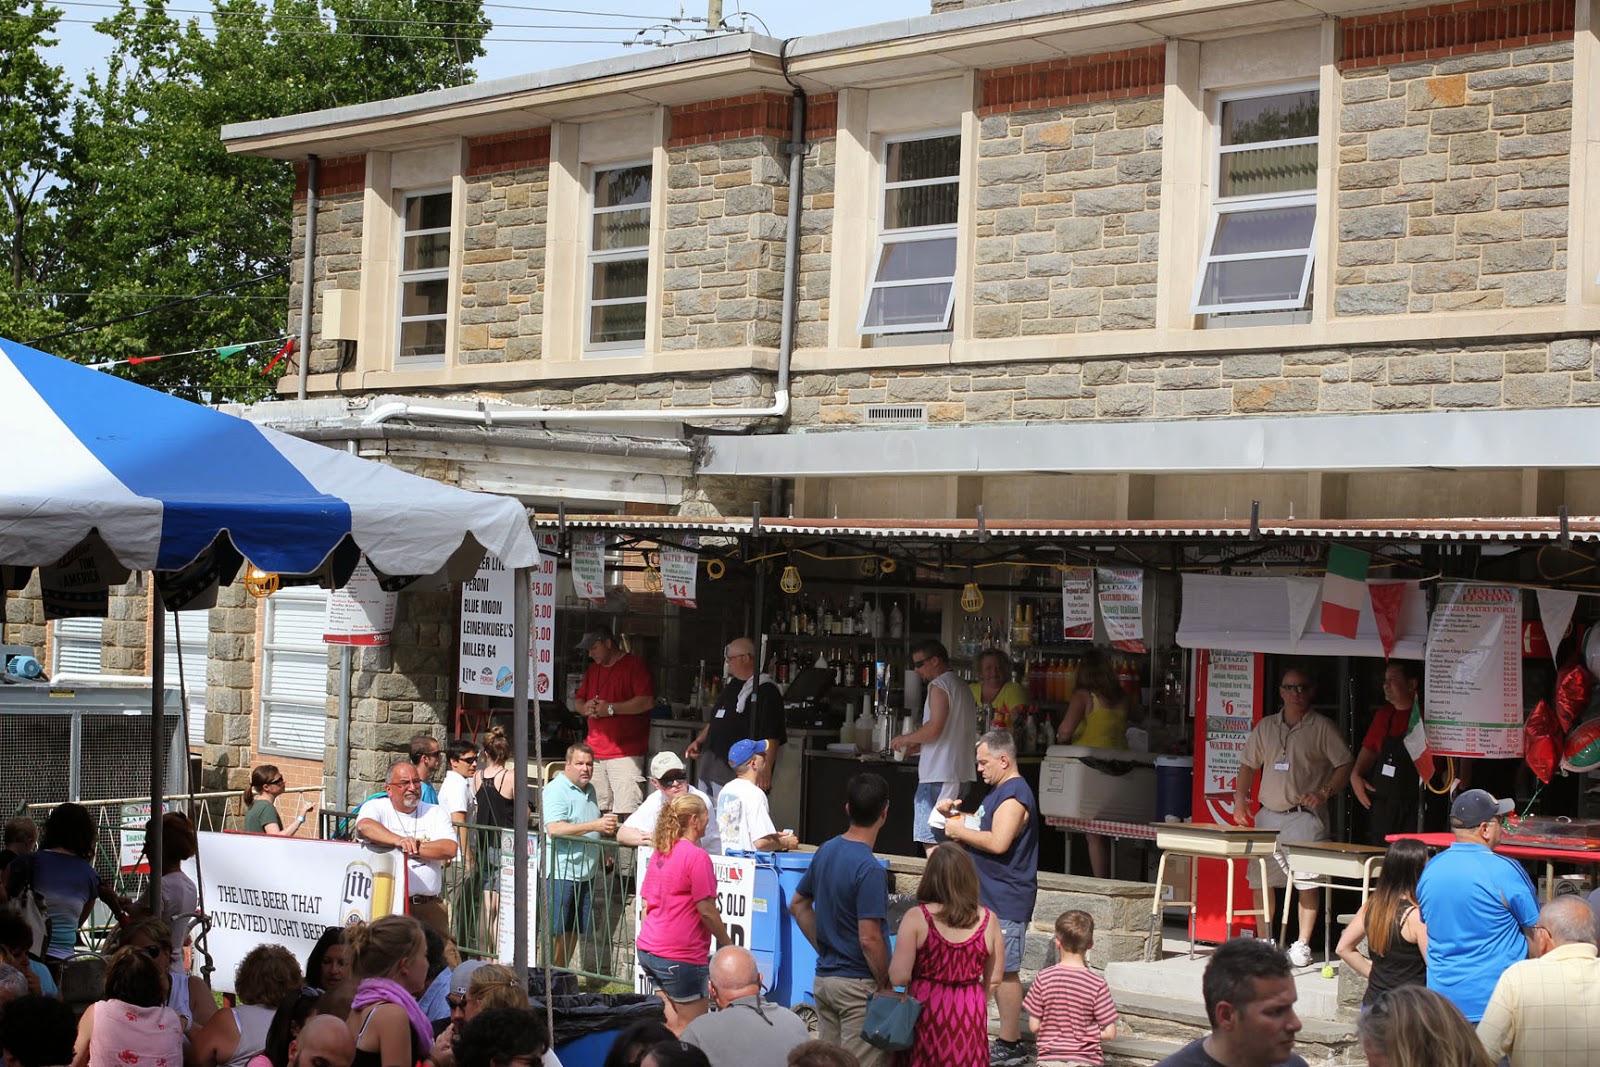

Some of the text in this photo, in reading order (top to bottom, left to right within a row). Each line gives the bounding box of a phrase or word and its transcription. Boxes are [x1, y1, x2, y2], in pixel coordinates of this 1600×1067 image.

[464, 578, 489, 592] PERONI
[532, 582, 552, 596] $5.00
[584, 582, 592, 594] $6
[668, 584, 686, 596] $14
[464, 599, 502, 615] BLUE MOON
[1120, 605, 1138, 614] Italian
[464, 620, 513, 638] LEINENKUGEL'S
[463, 642, 496, 658] MILLER 64
[462, 668, 476, 684] Lite
[1222, 699, 1233, 715] $6
[1209, 742, 1234, 750] WATER
[1213, 775, 1237, 790] $14
[344, 871, 372, 904] Lite
[218, 885, 322, 914] THE LITE BEER THAT
[727, 893, 746, 917] OLD
[211, 911, 267, 933] INVENTED
[269, 918, 300, 938] LIGHT
